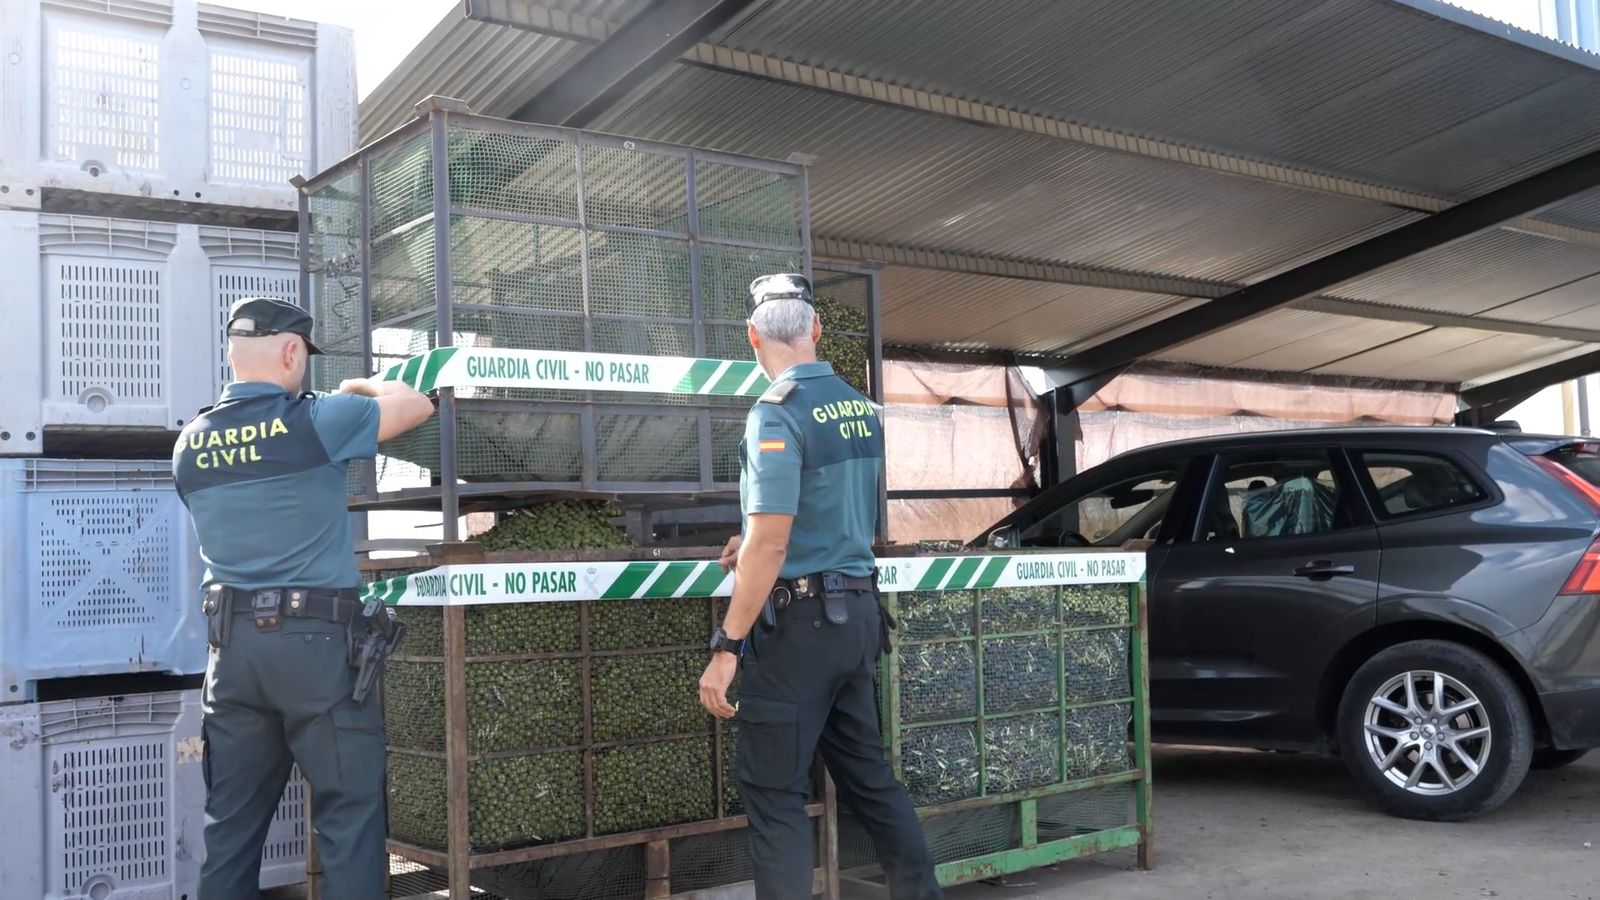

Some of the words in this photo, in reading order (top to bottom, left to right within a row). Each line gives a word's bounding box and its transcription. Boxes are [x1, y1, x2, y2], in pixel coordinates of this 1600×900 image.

[467, 356, 530, 380] GUARDIA
[536, 359, 570, 381] CIVIL
[585, 362, 604, 383] NO
[610, 363, 649, 384] PASAR
[812, 400, 876, 424] GUARDIA
[839, 420, 872, 439] CIVIL
[196, 445, 262, 469] CIVIL
[878, 565, 898, 585] SAR
[1016, 561, 1055, 580] GUARDIA
[1058, 560, 1077, 578] CIVIL
[1087, 560, 1099, 577] NO
[1102, 559, 1126, 577] PASAR
[415, 574, 448, 597] GUARDIA
[450, 573, 487, 597] CIVIL
[505, 572, 526, 594] NO
[532, 570, 577, 594] PASAR
